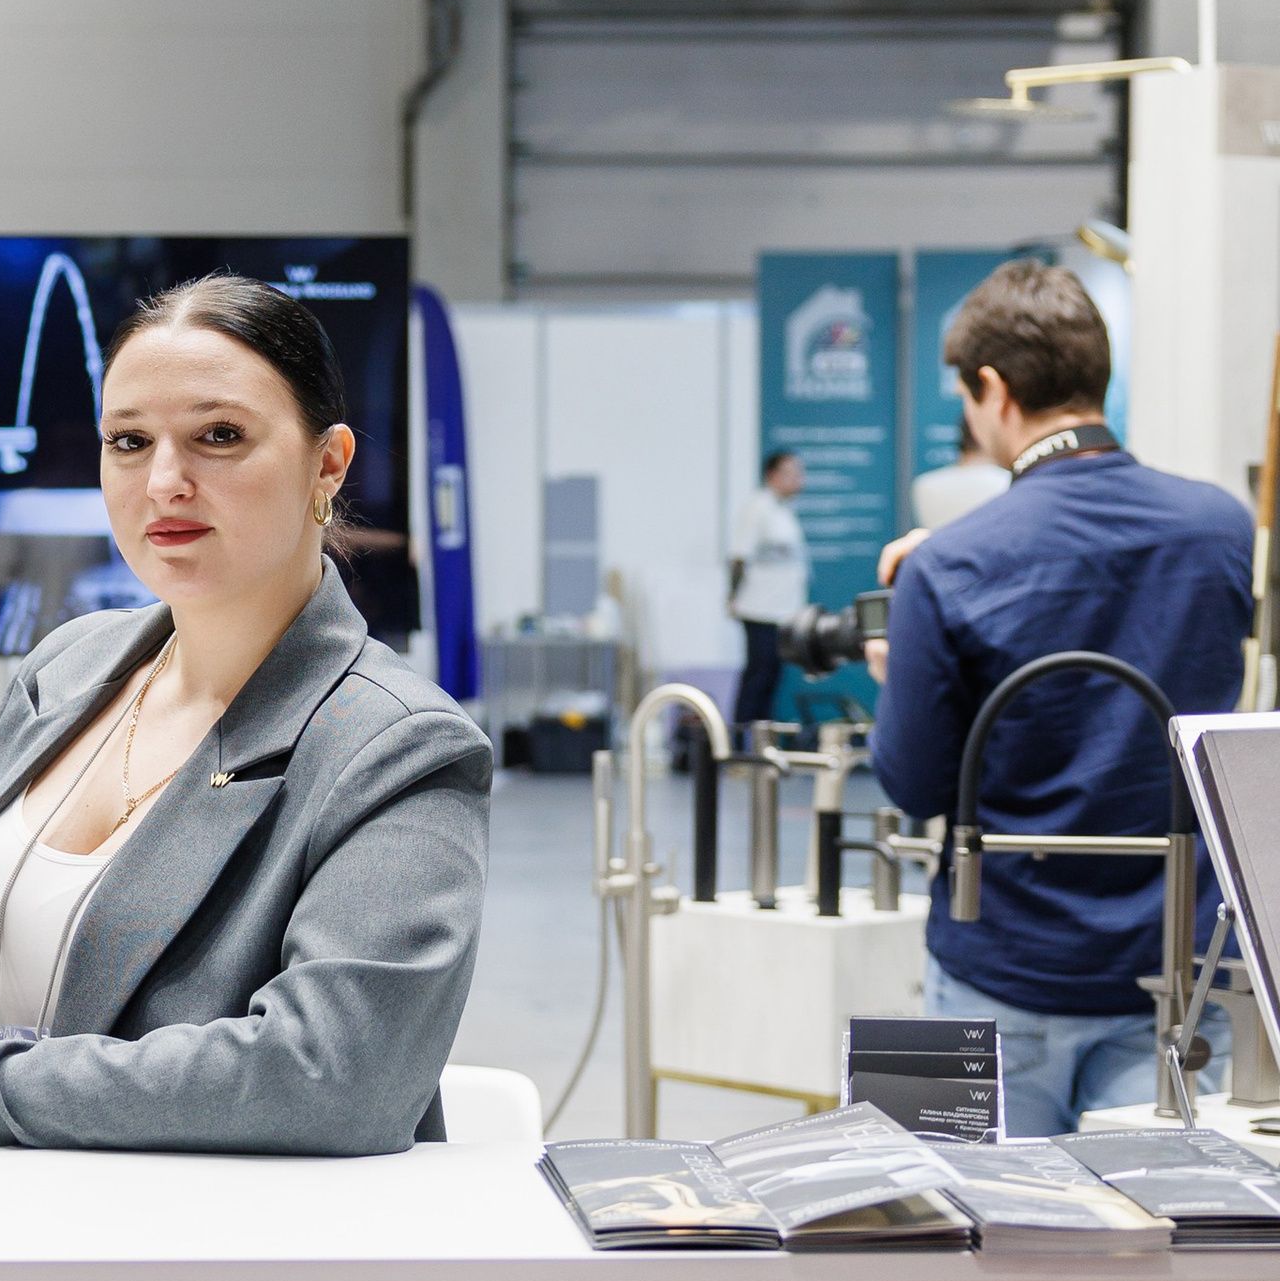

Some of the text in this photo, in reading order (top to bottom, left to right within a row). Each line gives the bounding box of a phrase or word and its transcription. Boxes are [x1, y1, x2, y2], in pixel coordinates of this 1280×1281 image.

[920, 1108, 990, 1121] ГАЛИНА ВЛАДИМИРОВНА
[955, 1106, 990, 1115] СИТНИКОВА
